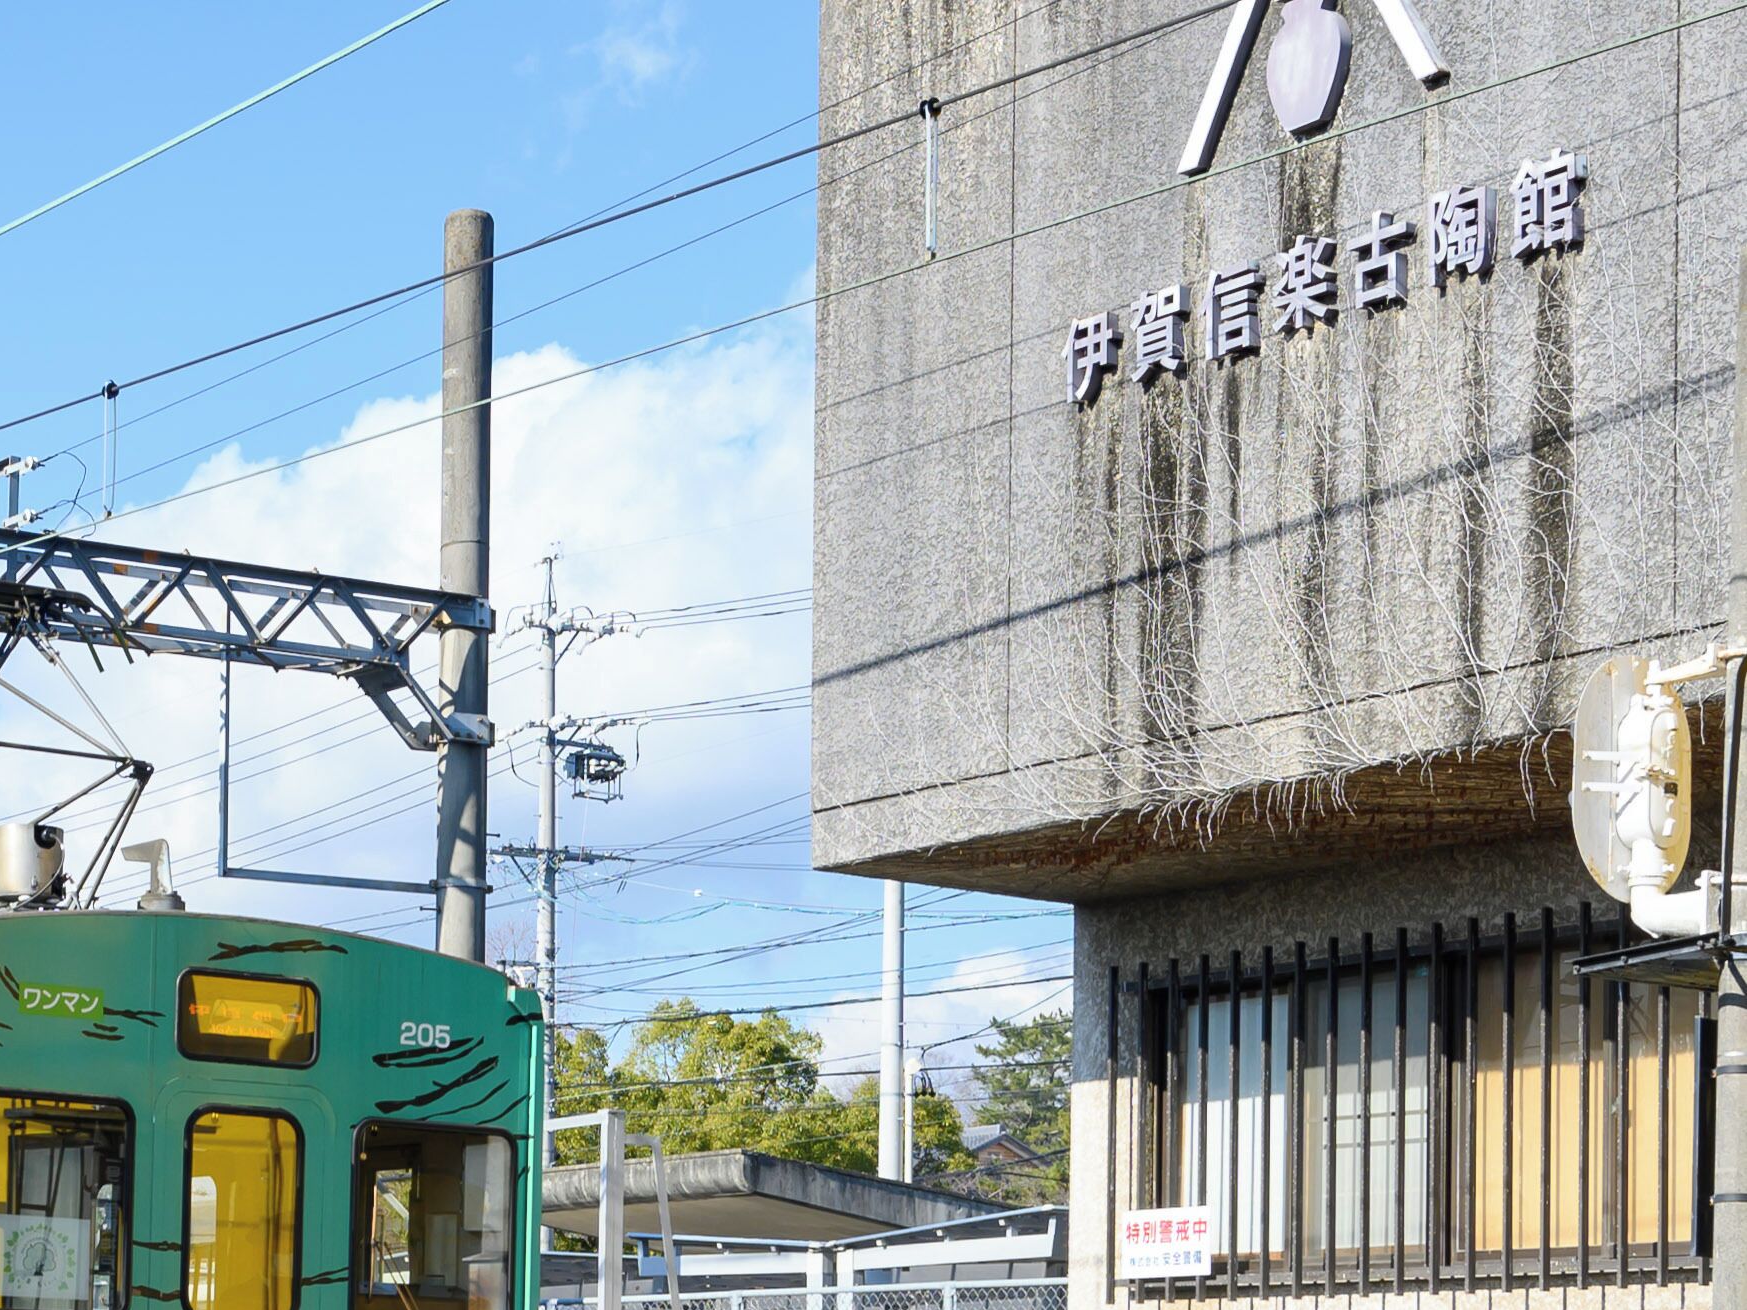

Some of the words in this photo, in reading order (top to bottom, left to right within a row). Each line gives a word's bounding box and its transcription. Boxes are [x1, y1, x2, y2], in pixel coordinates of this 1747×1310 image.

[1062, 146, 1588, 404] 伊賀信楽古陶館
[23, 987, 99, 1014] ワンマン
[400, 1021, 451, 1049] 205
[1125, 1217, 1208, 1245] 特別警戒中
